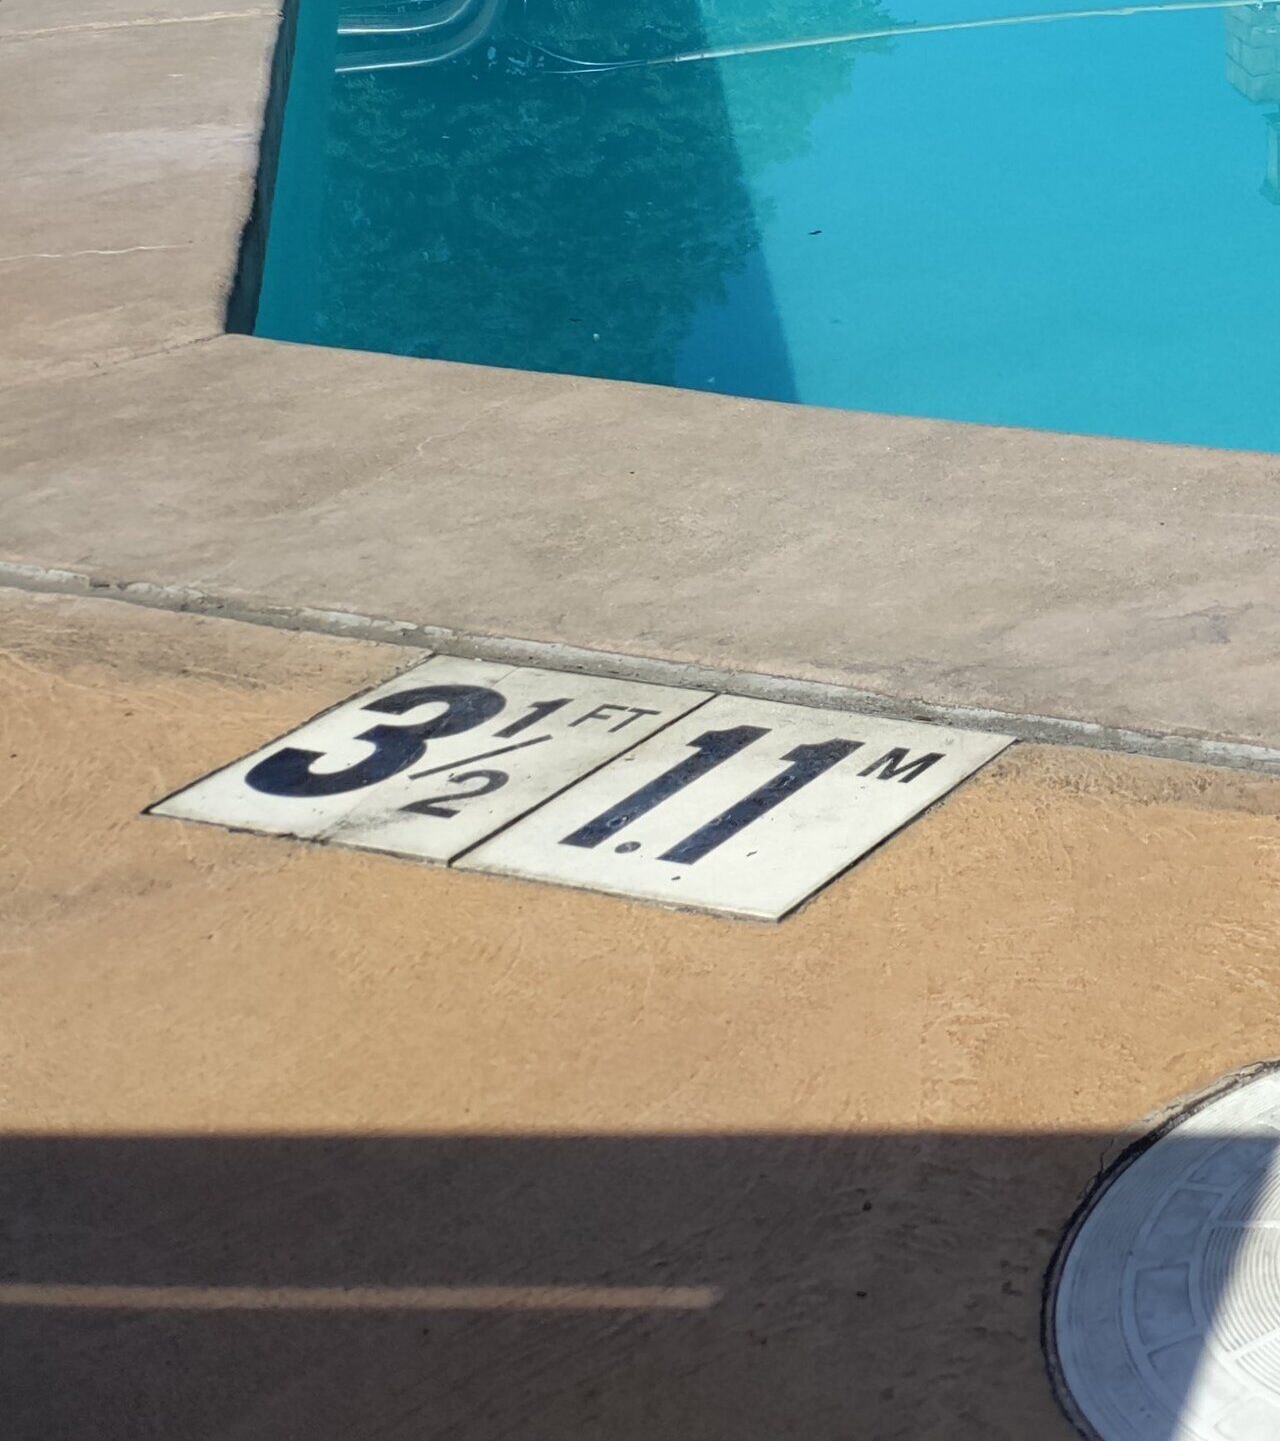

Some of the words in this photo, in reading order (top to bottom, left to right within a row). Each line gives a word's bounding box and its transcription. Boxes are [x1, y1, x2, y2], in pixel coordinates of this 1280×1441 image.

[566, 703, 661, 734] FT
[557, 724, 866, 866] 1.1
[856, 746, 947, 786] M
